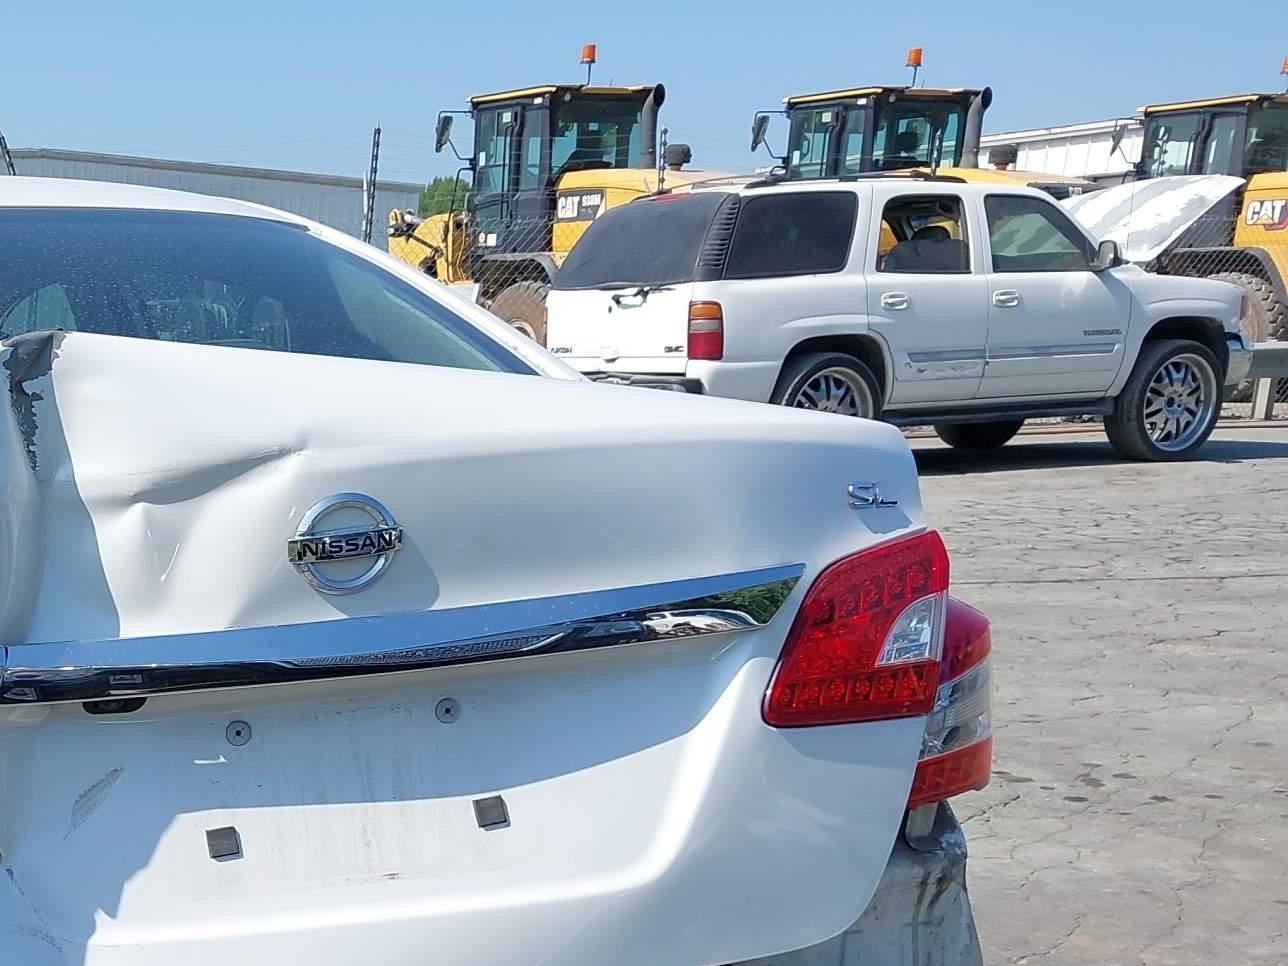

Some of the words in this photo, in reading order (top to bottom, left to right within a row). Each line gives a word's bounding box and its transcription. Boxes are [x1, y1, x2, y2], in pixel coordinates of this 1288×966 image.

[557, 196, 580, 219] CAT
[1246, 200, 1286, 225] CAT
[847, 482, 899, 509] SL
[301, 531, 393, 557] NISSAN
